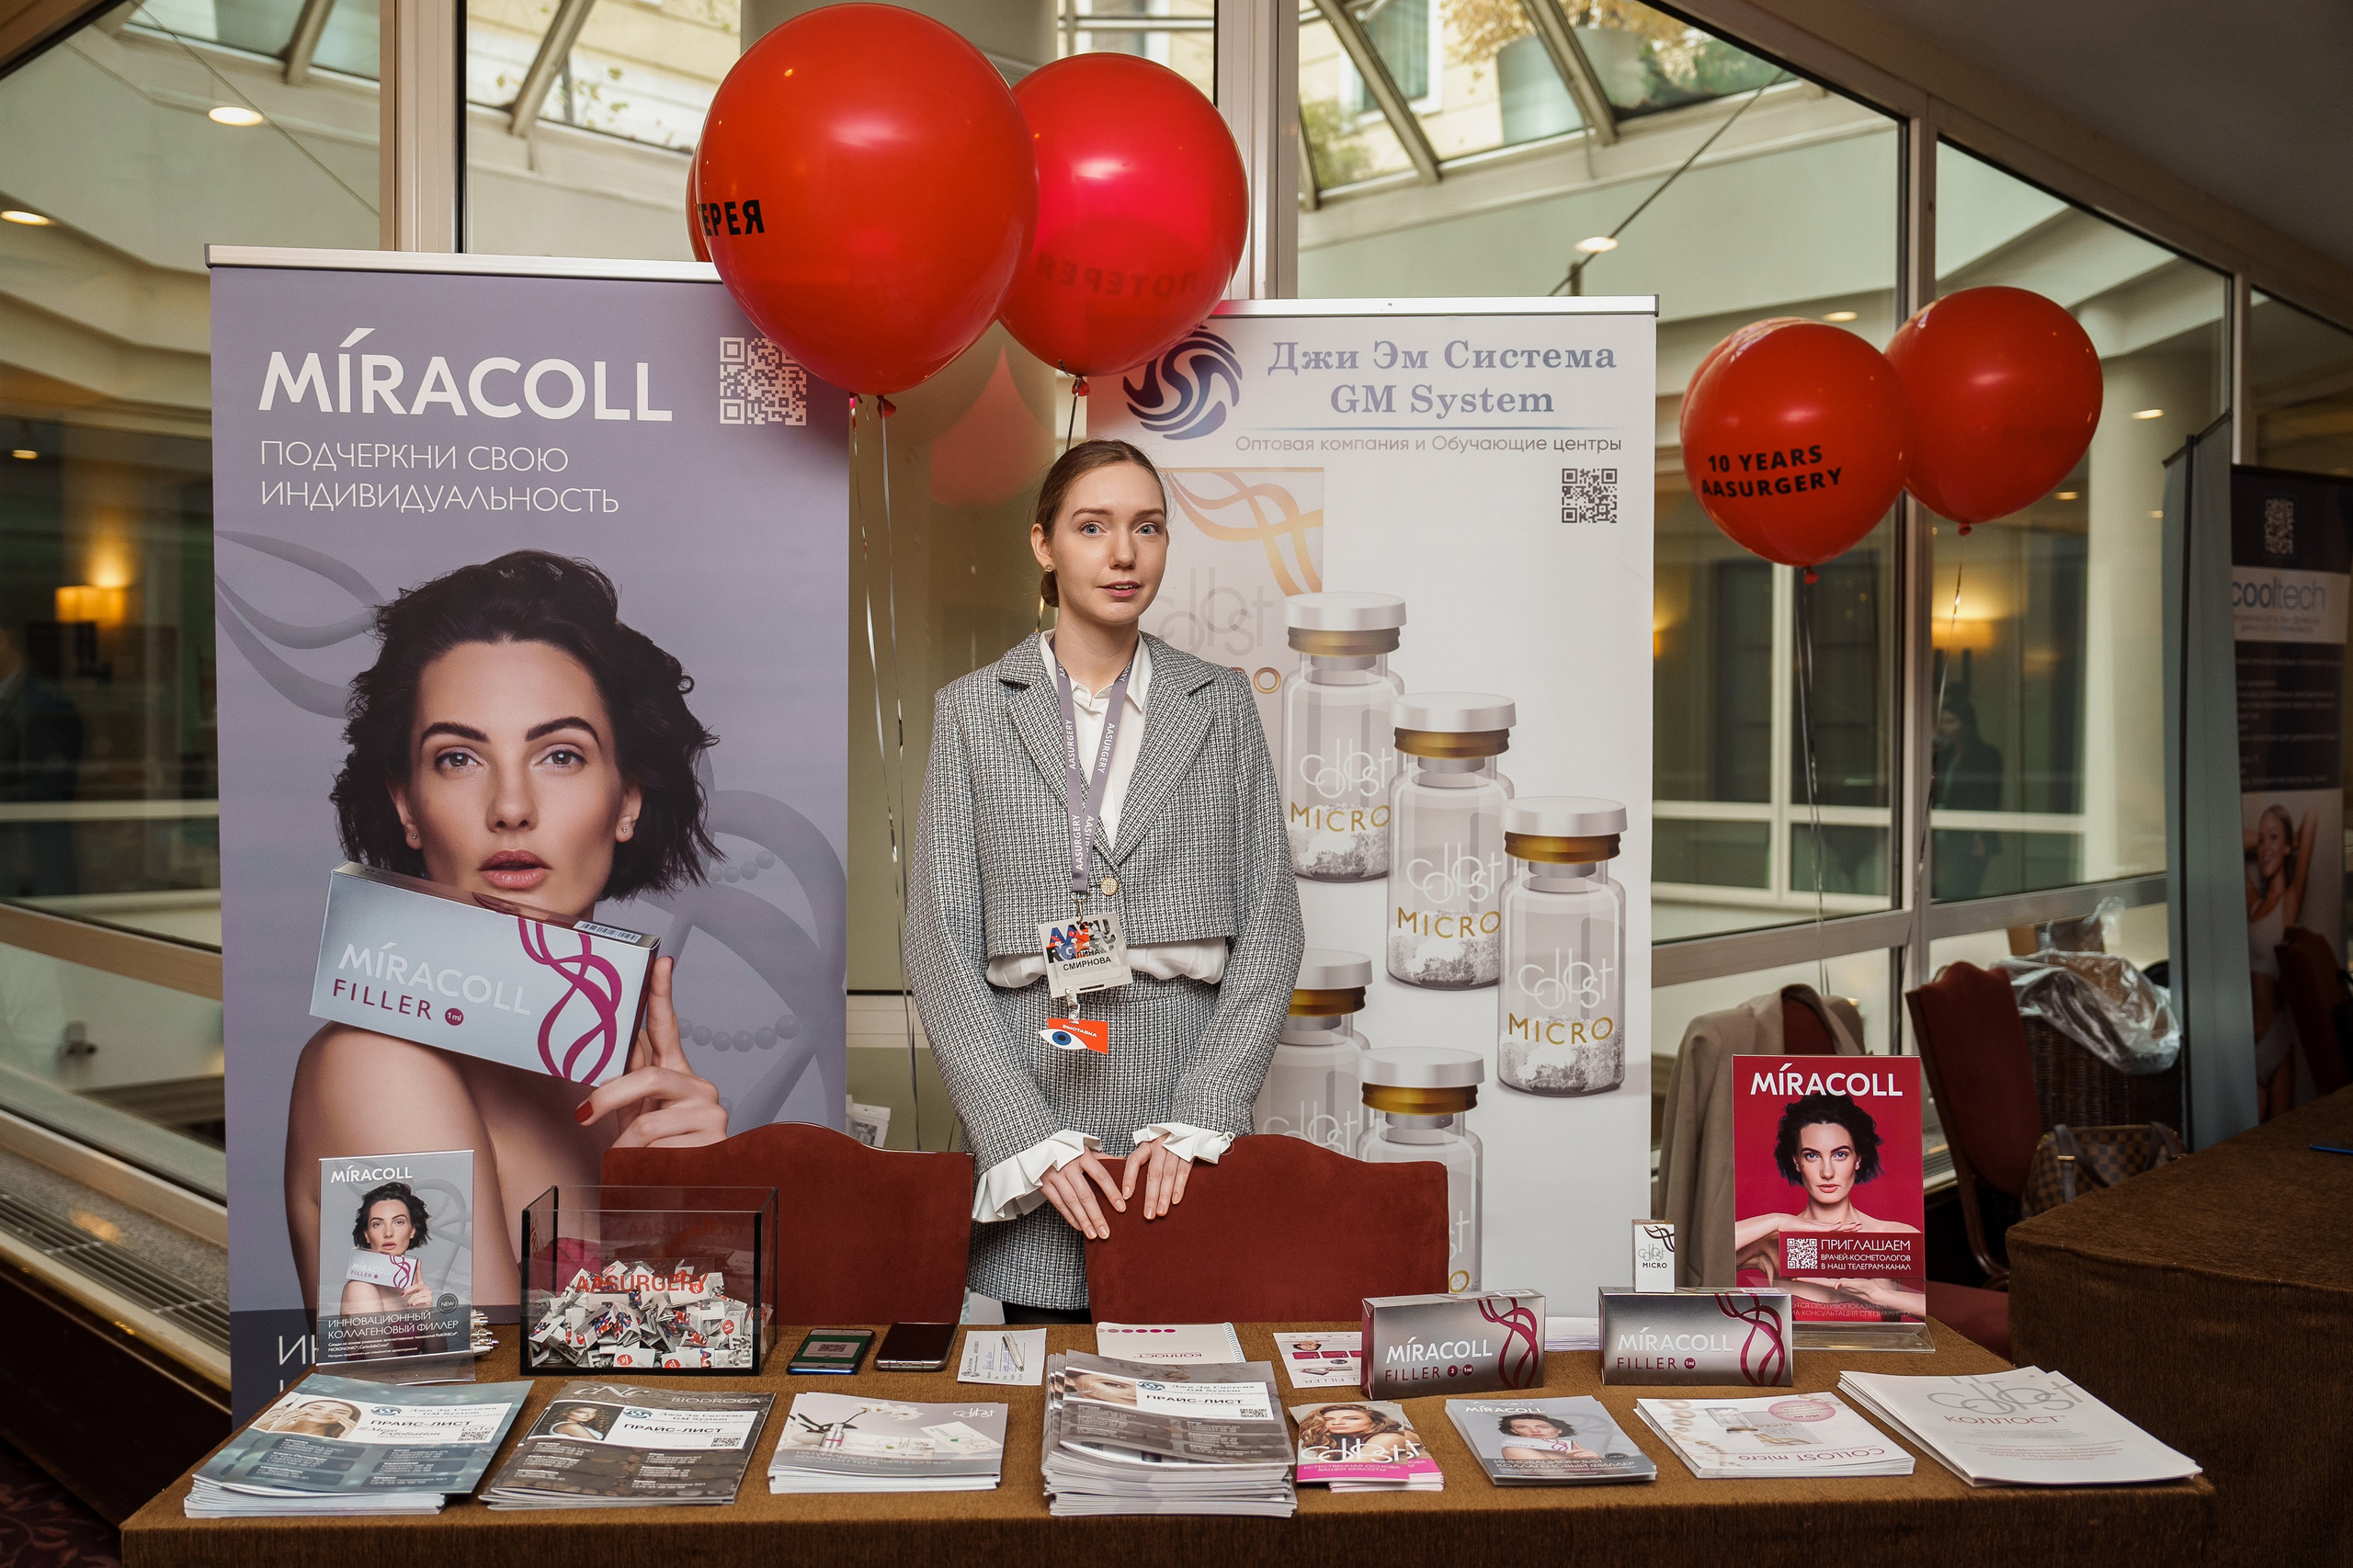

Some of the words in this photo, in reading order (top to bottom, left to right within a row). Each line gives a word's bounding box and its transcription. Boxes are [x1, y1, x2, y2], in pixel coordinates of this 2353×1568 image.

[698, 199, 765, 236] ЕРЕЯ
[1268, 342, 1358, 375] Джи
[1373, 340, 1428, 369] Эм
[1444, 340, 1617, 369] Система
[258, 328, 672, 421] MÍRACOLL
[1330, 384, 1396, 413] GM
[1410, 384, 1554, 419] System
[260, 440, 457, 471] ПОДЧЕРКНИ
[468, 447, 569, 472] СВОЮ
[1235, 436, 1314, 452] Оптовая
[1320, 437, 1409, 451] компания
[1415, 439, 1426, 450] и
[1432, 436, 1548, 454] Обучающие
[1553, 437, 1621, 455] центры
[1708, 454, 1730, 472] 10
[1739, 446, 1823, 472] YEARS
[1701, 467, 1843, 498] AASURGERY
[261, 481, 619, 514] ИНДИВИДУАЛЬНОСТЬ
[2232, 577, 2326, 611] cooltech
[1064, 718, 1076, 770] AASURGERY
[1097, 722, 1115, 774] AASURGERY
[1290, 801, 1392, 833] MICRO
[1072, 814, 1084, 870] AASURGERY
[1397, 906, 1502, 938] MICRO
[1063, 956, 1111, 971] СМИРНОВА
[1071, 948, 1101, 960] АЛИНА
[336, 942, 532, 1016] MÍRACOLL
[333, 979, 432, 1020] FILLER
[1063, 1024, 1097, 1038] ВЫСТАВКА
[1508, 1013, 1614, 1045] MICRO
[1750, 1062, 1904, 1097] MÍRACOLL
[330, 1165, 413, 1184] MÍRACOLL
[1821, 1239, 1911, 1251] ПРИГЛАШАЕМ
[1821, 1253, 1912, 1262] ВРАЧЕЙ-КОСМЕТОЛОГОВ
[574, 1273, 709, 1294] AASURGERY
[328, 1310, 431, 1328] ИННОВАЦИОННЫЙ
[328, 1323, 415, 1340] КОЛЛАГЕНОВЫЙ
[416, 1320, 460, 1332] ФИЛЛЕР
[1385, 1336, 1494, 1364] MÍRACOLL
[1618, 1327, 1734, 1353] MÍRACOLL
[1384, 1366, 1441, 1382] FILLER
[1617, 1357, 1677, 1370] FILLER
[671, 1396, 762, 1404] BIODROGA
[1146, 1394, 1244, 1404] ПРАЙС-ЛИСТ
[623, 1424, 724, 1433] ПРАЙС-ЛИСТ
[1796, 1448, 1885, 1461] COLLOST
